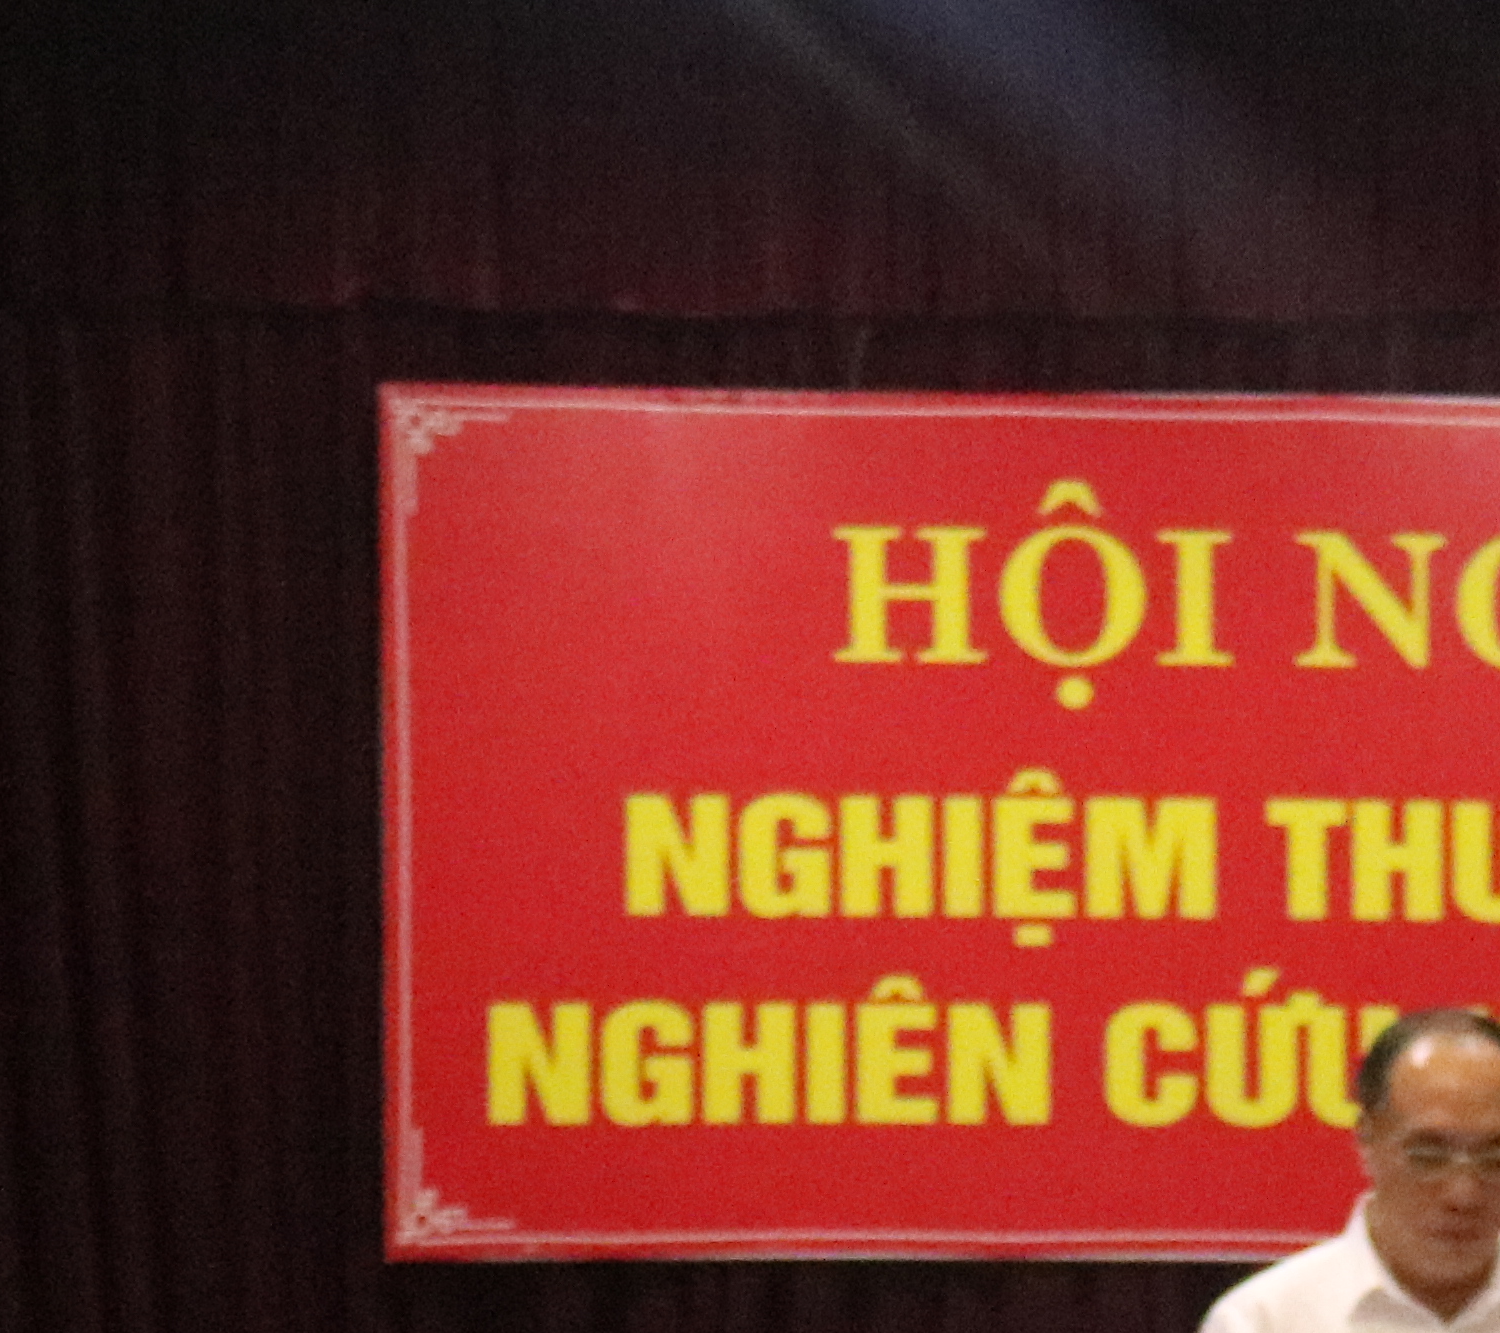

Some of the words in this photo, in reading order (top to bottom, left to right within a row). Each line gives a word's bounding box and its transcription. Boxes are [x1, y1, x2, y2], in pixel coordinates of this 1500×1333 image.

[835, 481, 1233, 709] HỘI
[624, 768, 1219, 948] NGHIỆM
[487, 975, 1052, 1127] NGHIÊN
